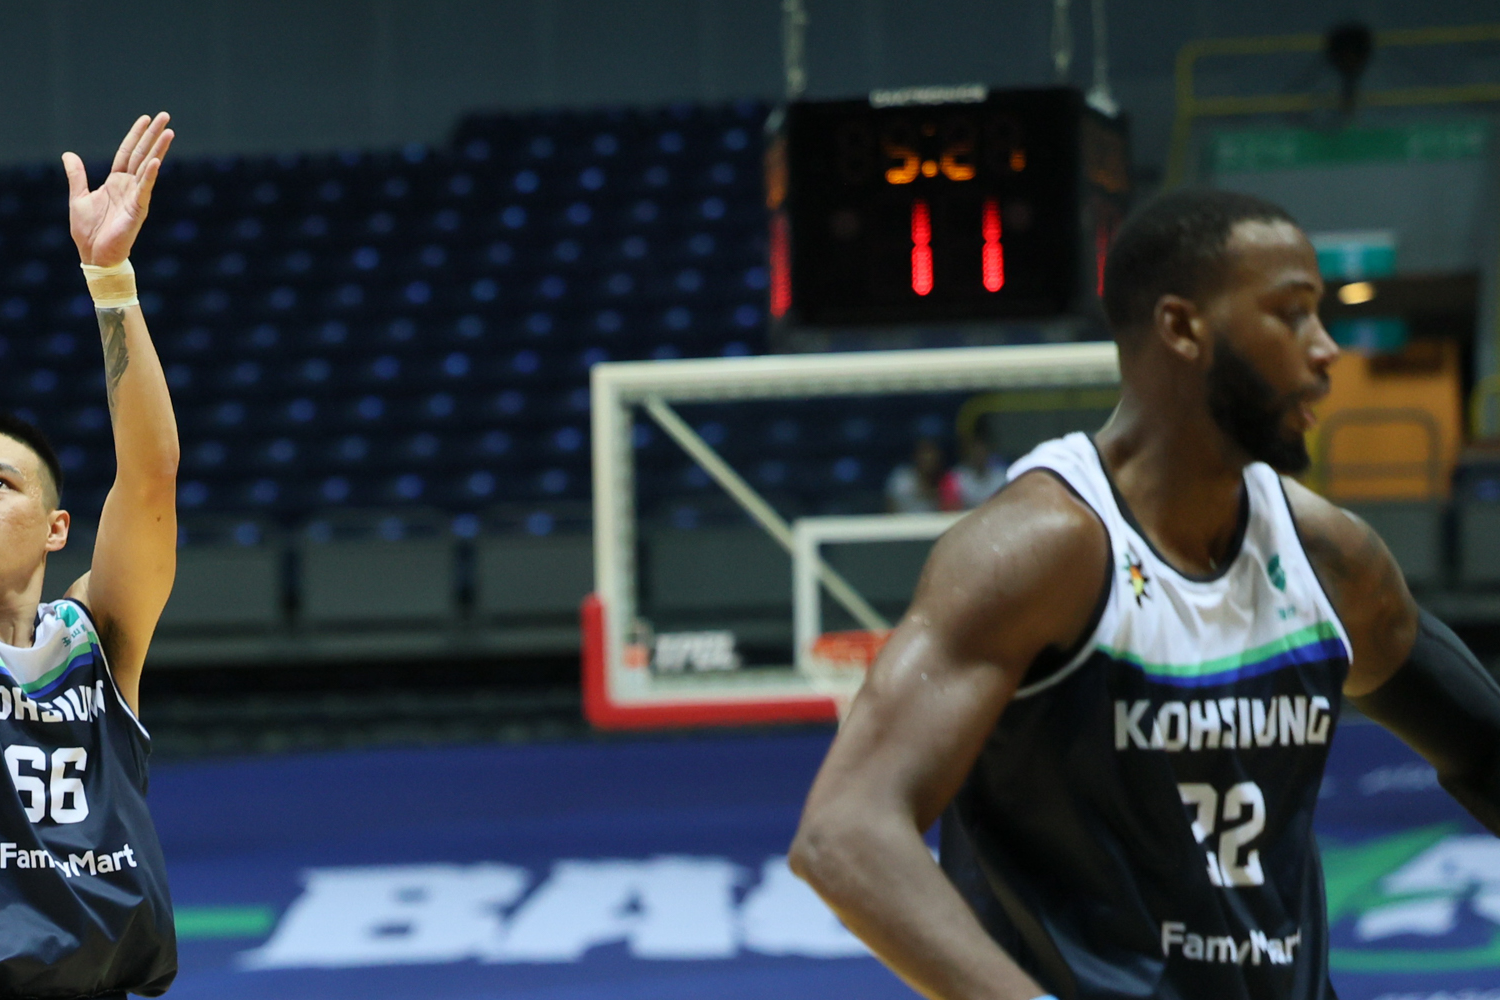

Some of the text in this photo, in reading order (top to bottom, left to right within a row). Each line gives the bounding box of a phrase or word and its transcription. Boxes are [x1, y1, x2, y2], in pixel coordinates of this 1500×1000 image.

[1114, 695, 1332, 753] KOHSIUNG
[3, 744, 90, 825] 66
[0, 842, 138, 878] FamyMart
